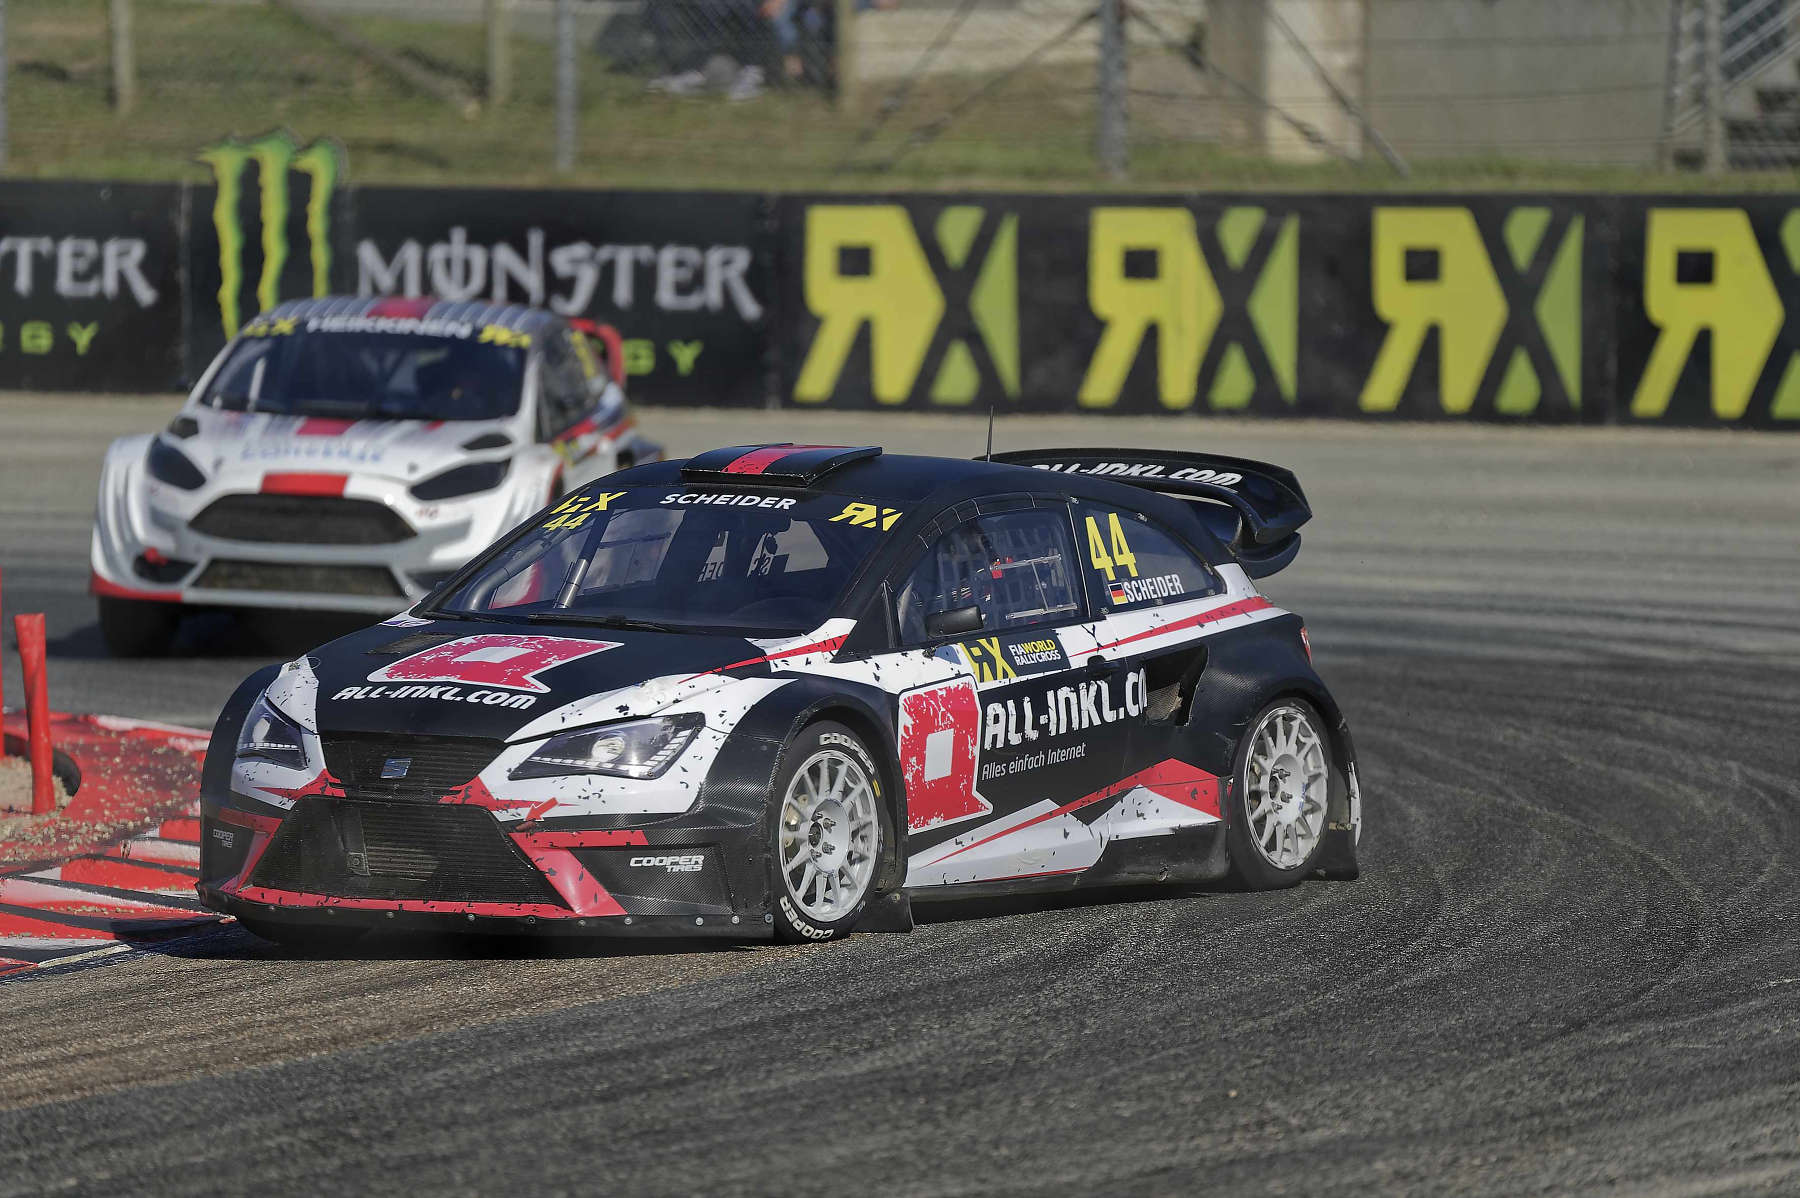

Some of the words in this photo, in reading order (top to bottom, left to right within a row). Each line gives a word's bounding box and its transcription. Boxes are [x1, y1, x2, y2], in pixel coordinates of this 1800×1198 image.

[356, 226, 762, 322] MONSTER
[0, 320, 99, 355] GY
[659, 493, 797, 510] SCHEIDER
[542, 512, 592, 532] 44
[1085, 512, 1139, 581] 44
[1123, 573, 1185, 603] SCHEIDER
[1014, 649, 1062, 666] RALLYCROSS
[330, 685, 537, 710] ALL-INKL.COM
[981, 762, 1006, 781] Alles
[1009, 750, 1045, 774] einfach
[1047, 742, 1086, 764] Internet
[629, 855, 704, 866] COOPER
[666, 864, 703, 872] TIRES
[779, 896, 835, 940] COOPER
